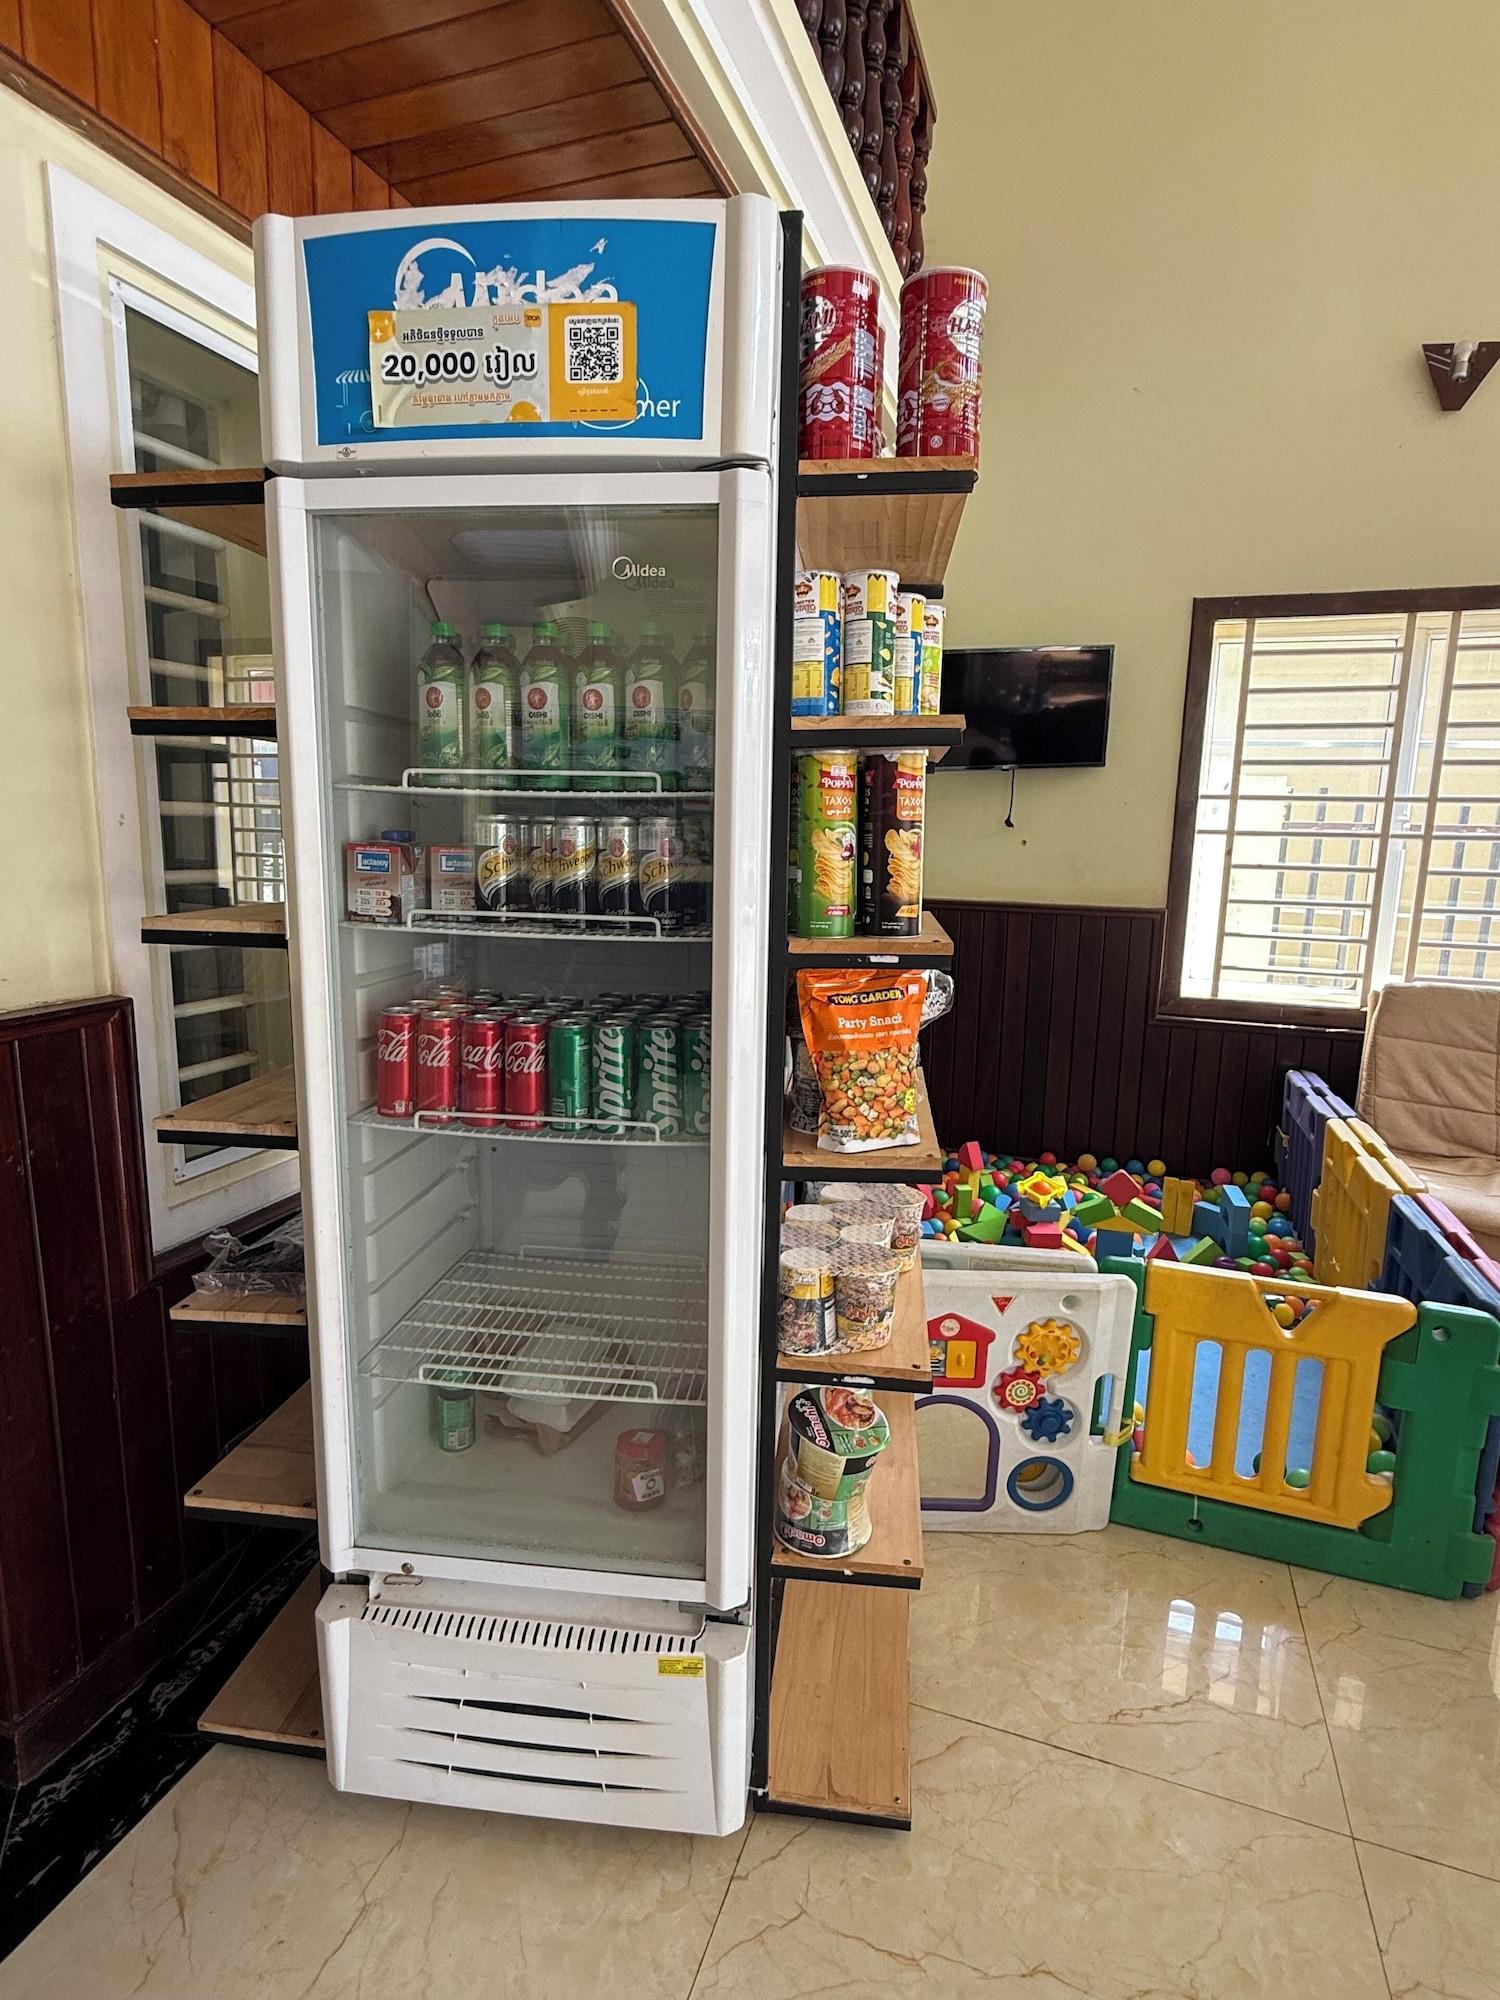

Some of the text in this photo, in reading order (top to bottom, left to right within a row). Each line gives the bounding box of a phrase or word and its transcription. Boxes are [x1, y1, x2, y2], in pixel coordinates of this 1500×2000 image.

[384, 345, 536, 381] 20,000 រៀល
[636, 399, 681, 418] mer
[612, 556, 666, 580] Midea
[528, 711, 548, 719] OISHI
[583, 712, 604, 720] OISHI
[824, 796, 853, 806] TAXOS
[356, 853, 389, 870] Lactasoy
[831, 989, 902, 1005] TONG GARDEN
[837, 1013, 904, 1030] Party Snack
[505, 1039, 546, 1073] Cola
[593, 1027, 632, 1135] Sprite
[643, 1027, 684, 1137] Sprite
